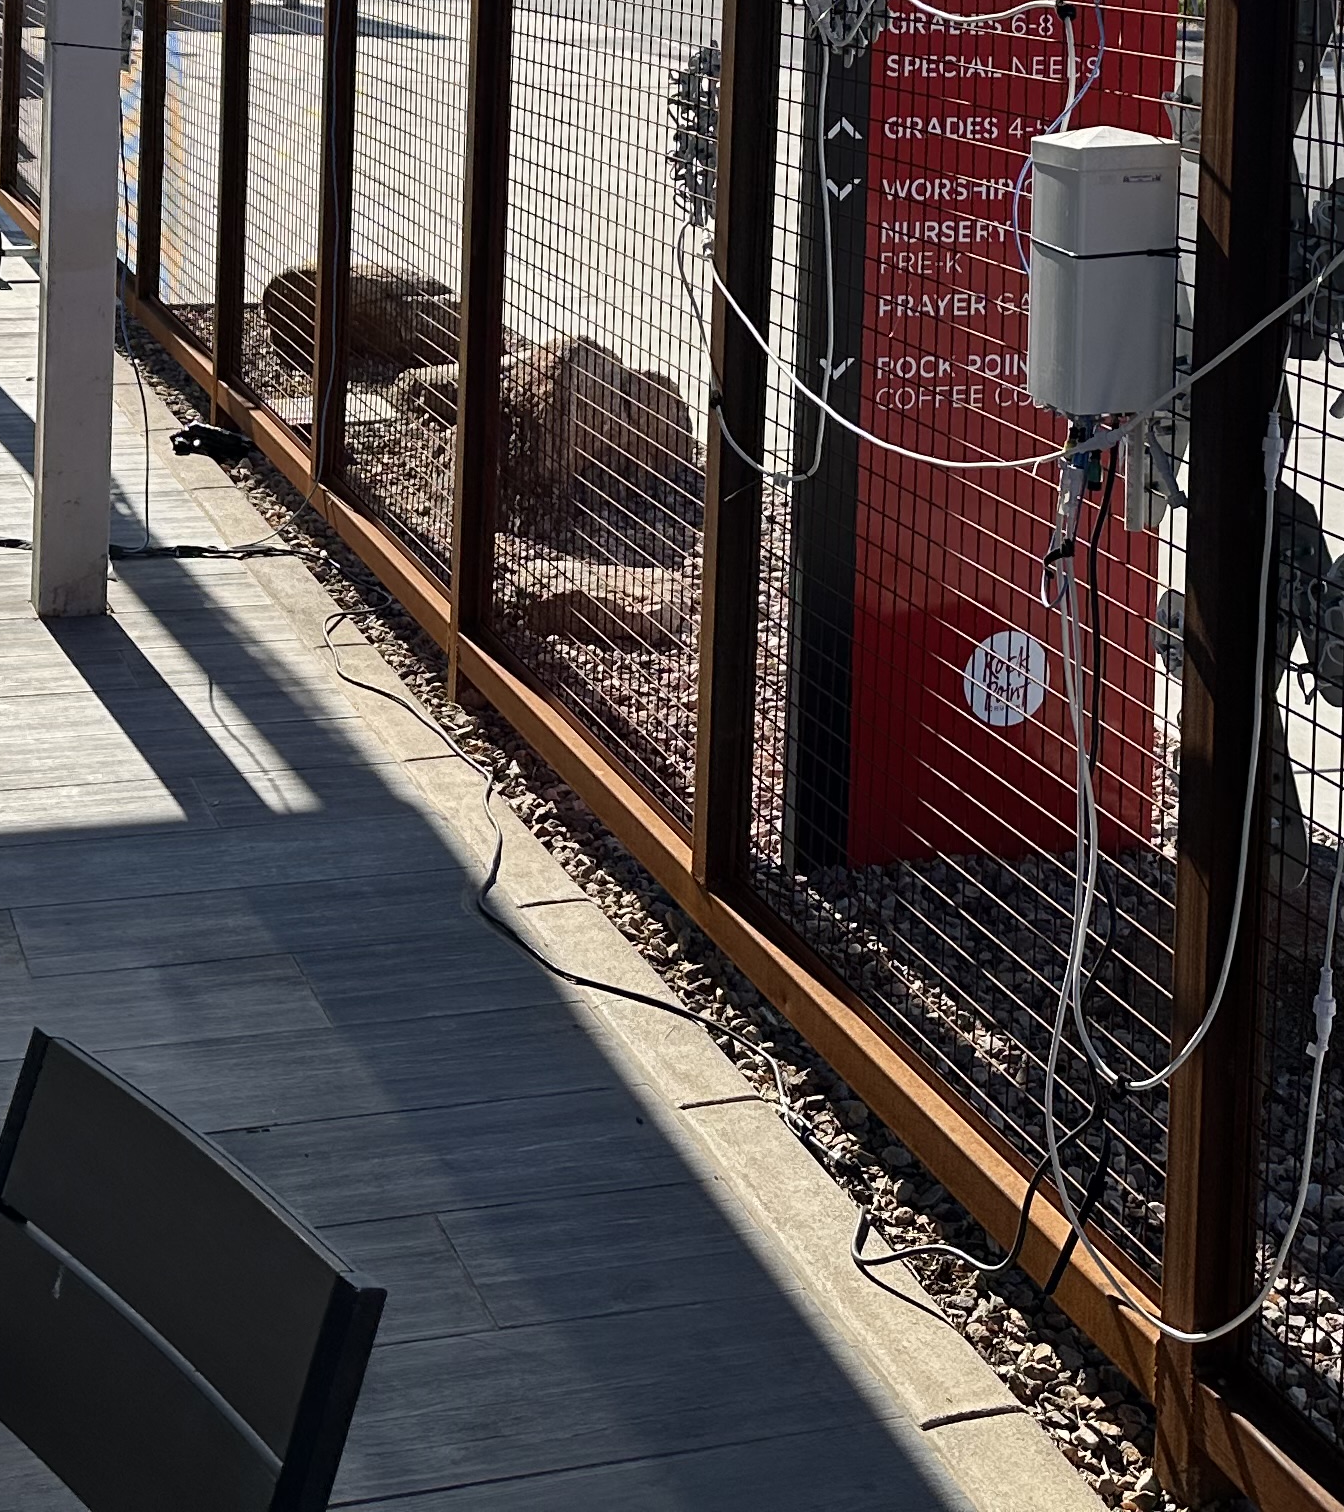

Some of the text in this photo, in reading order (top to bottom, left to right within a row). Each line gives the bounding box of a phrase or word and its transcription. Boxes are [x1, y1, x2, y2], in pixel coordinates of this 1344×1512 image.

[888, 12, 1054, 36] GRADES 6-8
[886, 54, 1003, 78] SPECIAL
[884, 116, 999, 139] GRADES
[882, 178, 1014, 201] WORSHIP
[881, 220, 1012, 244] NURSERY
[880, 251, 963, 275] PRE-K
[879, 292, 987, 317] PRAYER
[876, 353, 1028, 380] ROCK POIN
[875, 384, 984, 411] COFFEE
[982, 645, 1031, 683] Rock
